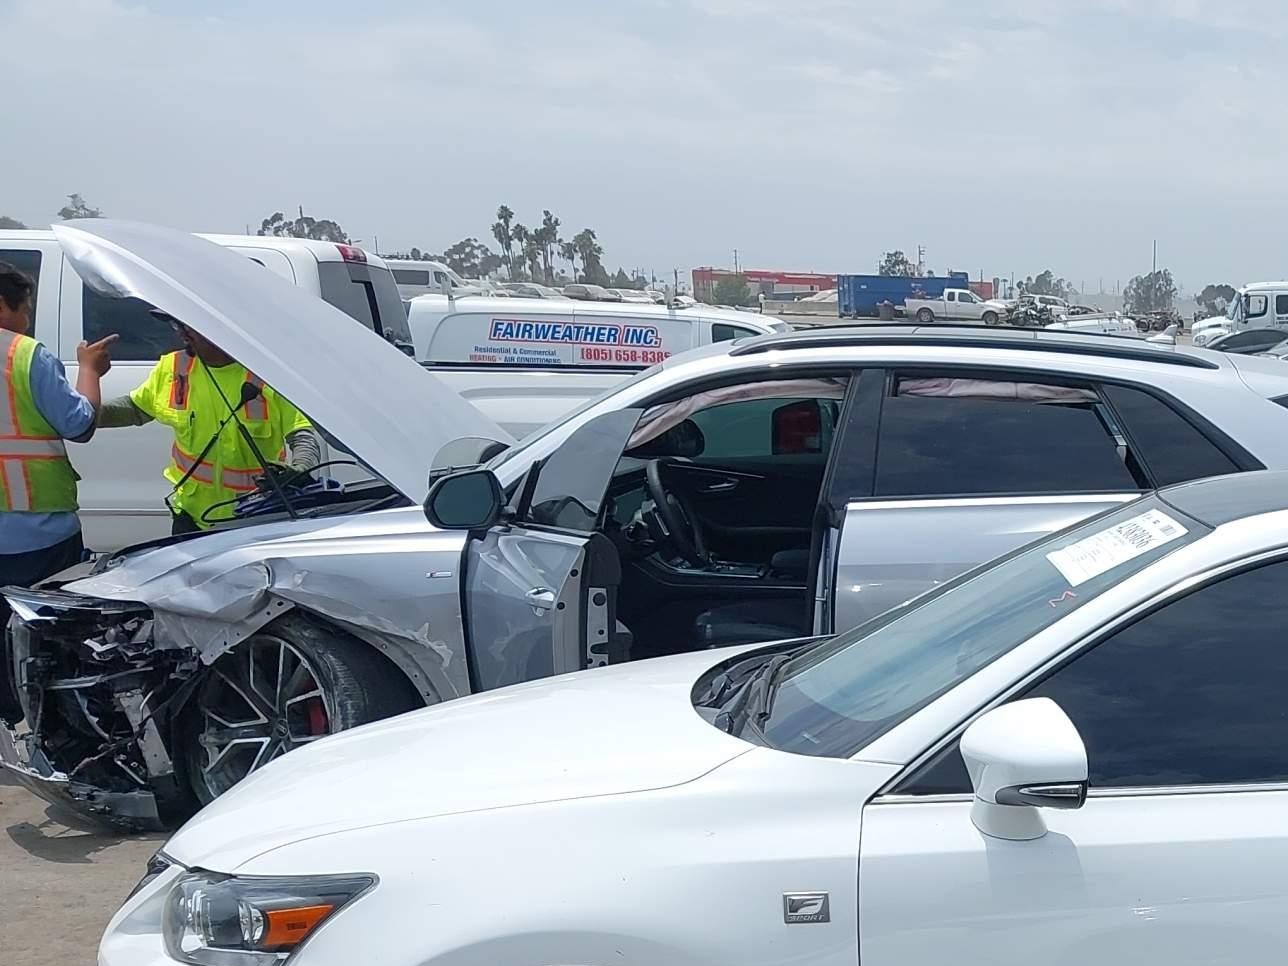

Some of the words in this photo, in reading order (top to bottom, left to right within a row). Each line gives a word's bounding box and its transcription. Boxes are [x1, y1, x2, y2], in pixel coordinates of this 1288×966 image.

[491, 322, 620, 344] FAIRWEATHER
[624, 327, 659, 345] INC.
[474, 345, 511, 354] Residential
[519, 348, 557, 356] Commercial
[581, 348, 612, 360] (805)
[469, 354, 497, 362] HEATING
[503, 355, 515, 363] AIR
[516, 356, 562, 364] CONDITIONING
